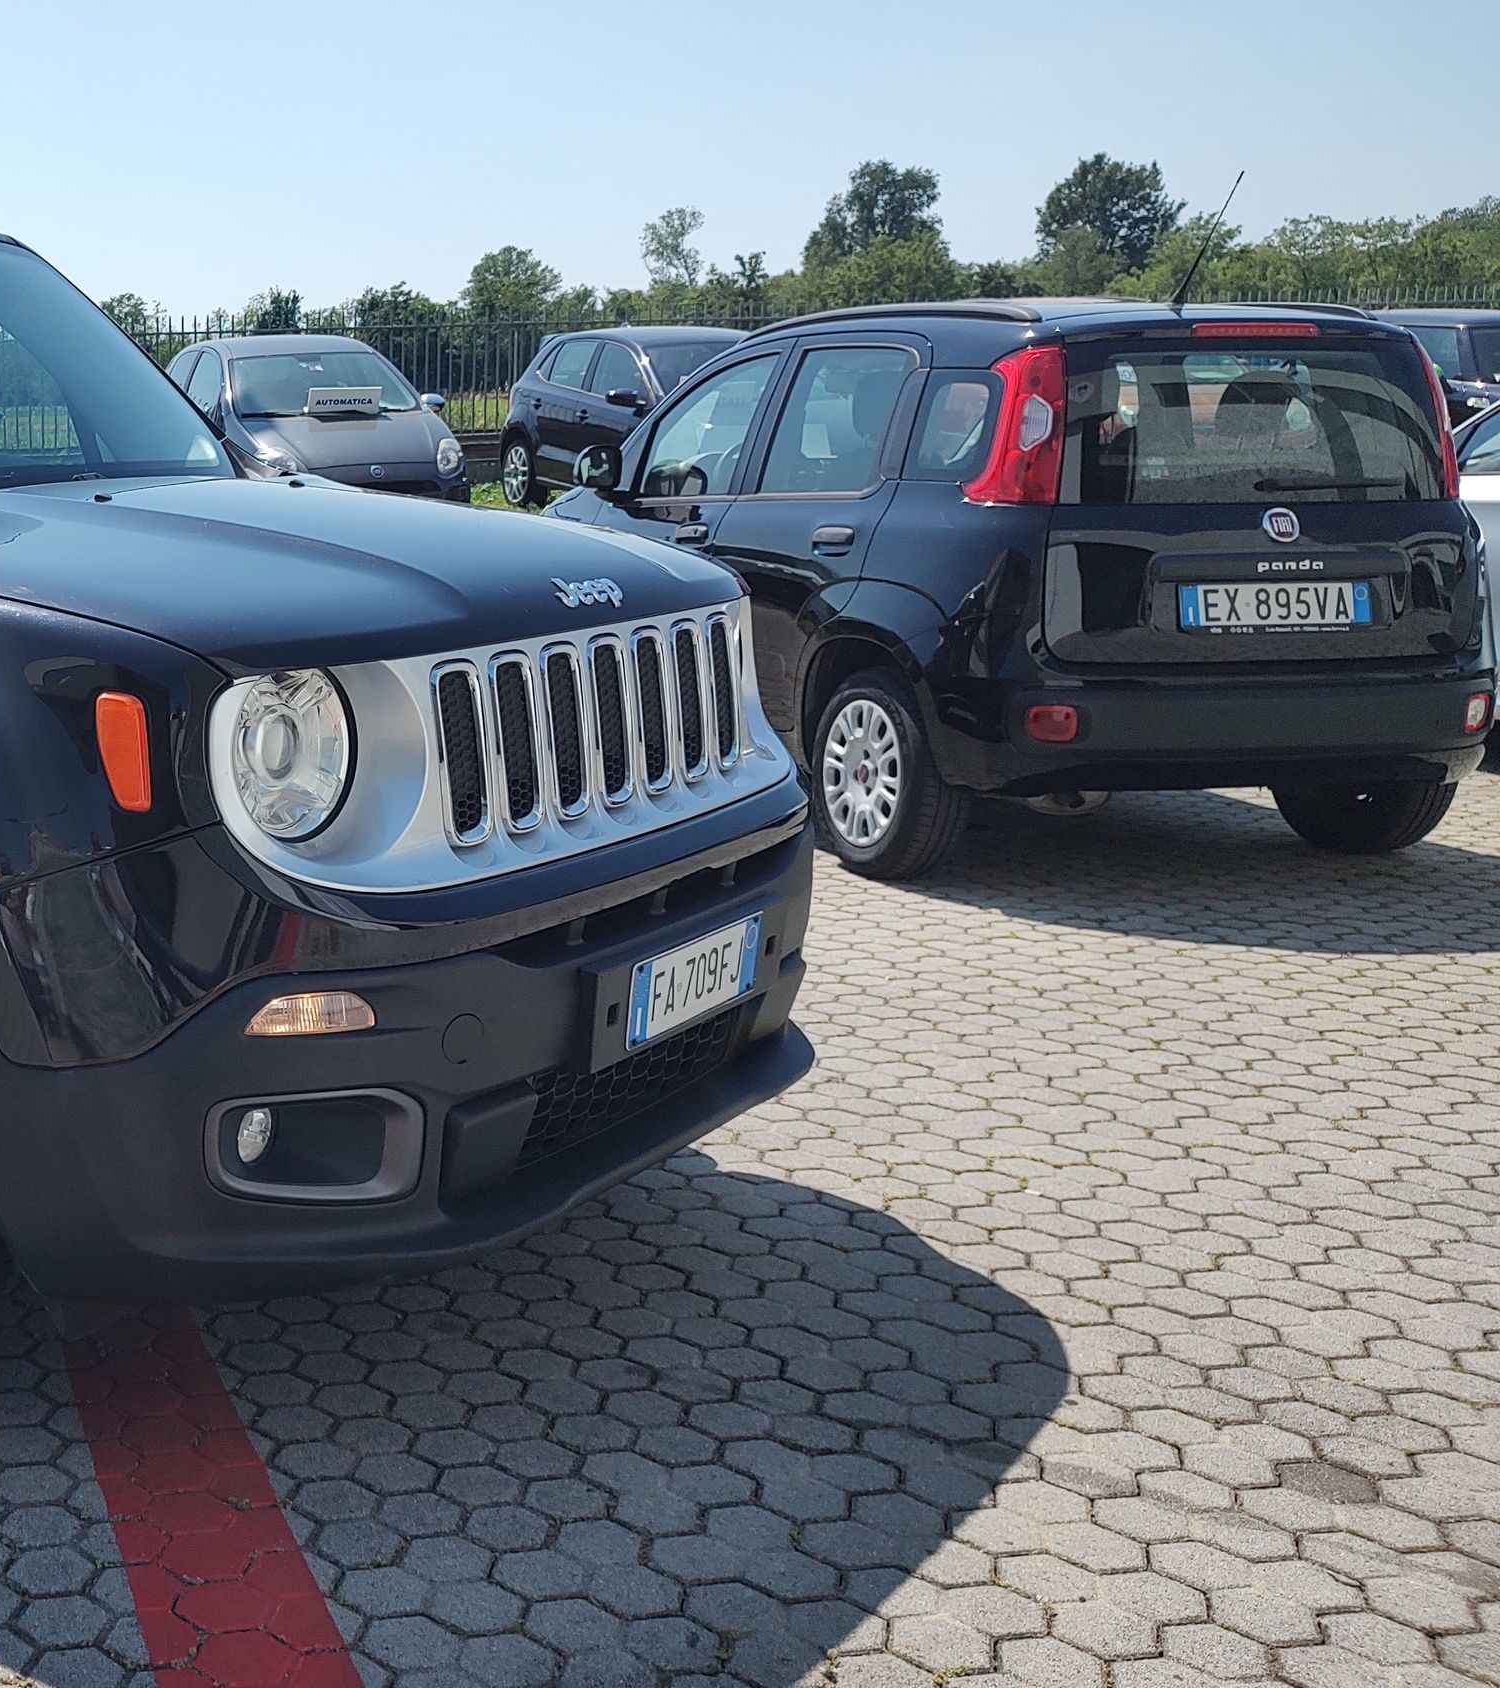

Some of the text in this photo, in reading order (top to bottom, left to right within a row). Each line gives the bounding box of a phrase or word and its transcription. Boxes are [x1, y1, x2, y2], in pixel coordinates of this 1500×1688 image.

[316, 398, 373, 406] AUTOMATICA
[1271, 516, 1293, 533] FIAT
[1257, 559, 1324, 573] panda
[551, 576, 624, 608] Jeep
[1203, 588, 1241, 622] EX
[1255, 586, 1350, 621] 895VA
[651, 966, 676, 1022] FA
[682, 936, 744, 1008] 709FJ
